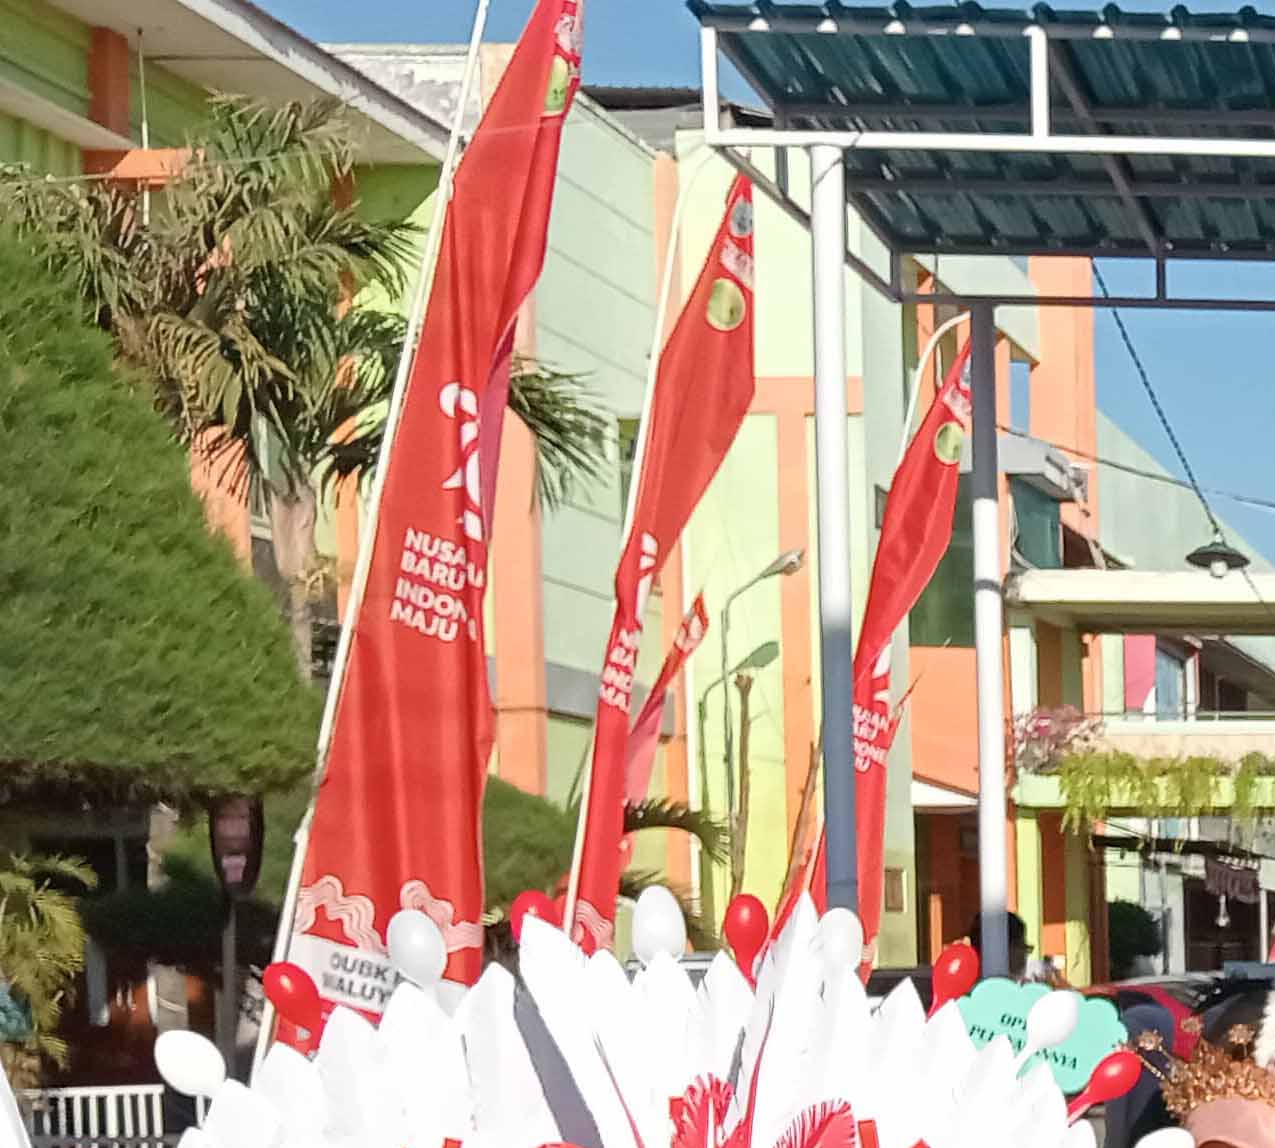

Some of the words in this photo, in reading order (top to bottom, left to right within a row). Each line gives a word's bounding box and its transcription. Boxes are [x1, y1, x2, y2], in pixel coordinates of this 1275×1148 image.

[400, 550, 466, 591] BARU
[390, 599, 458, 641] MAJU
[330, 952, 391, 983] OUBK
